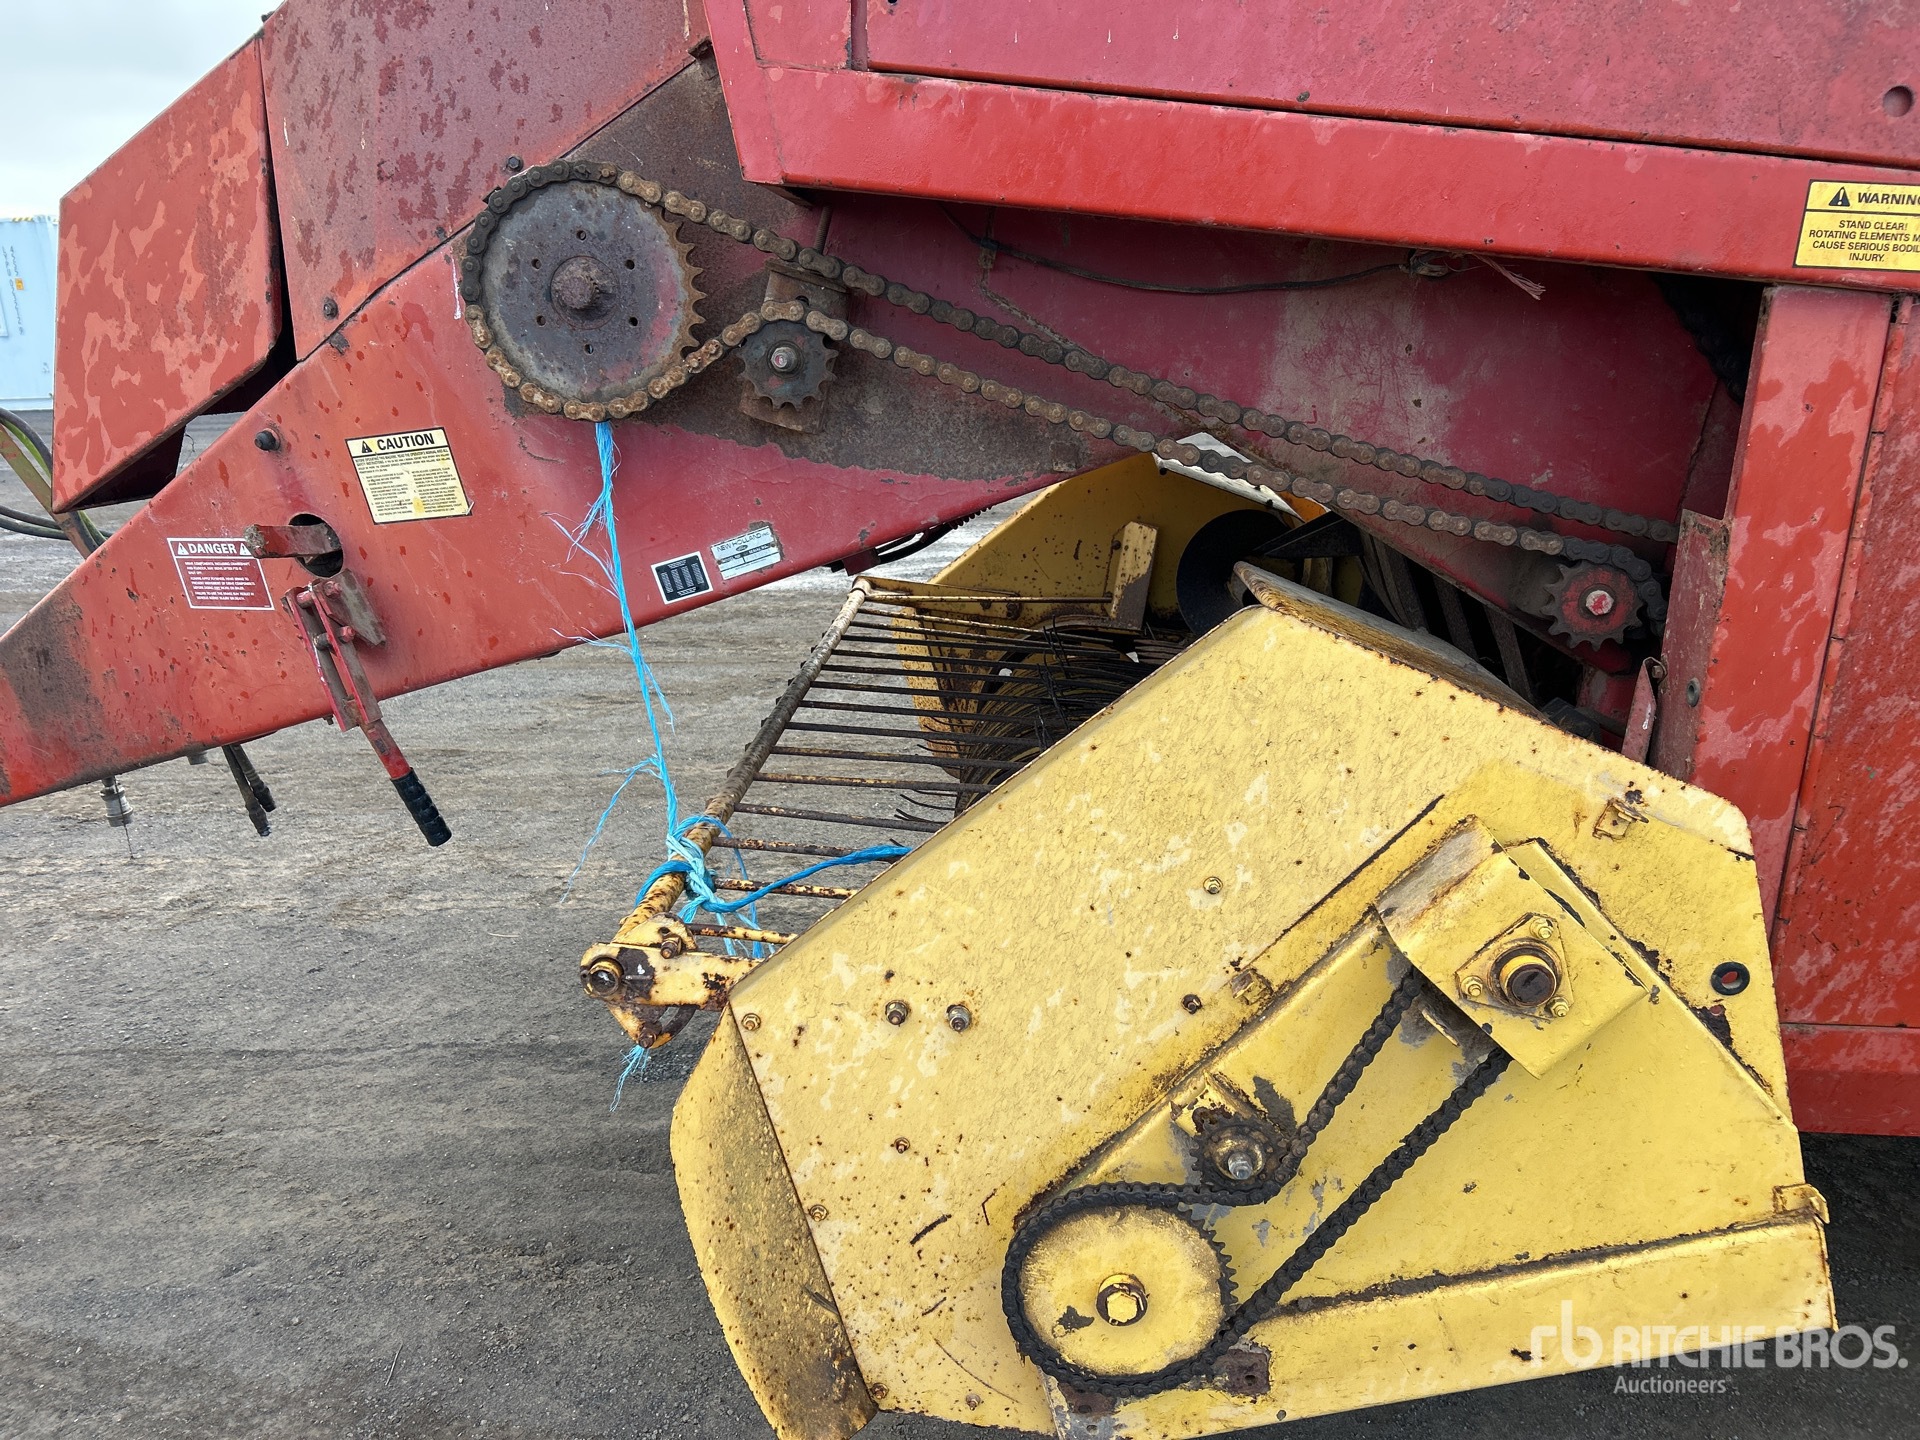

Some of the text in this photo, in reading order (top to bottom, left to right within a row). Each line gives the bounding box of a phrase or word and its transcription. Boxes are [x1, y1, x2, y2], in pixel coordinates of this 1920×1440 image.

[1857, 192, 1920, 206] WARNIN
[1839, 220, 1908, 231] STAND CLEAR!
[1809, 230, 1857, 240] ROTATING
[1859, 232, 1910, 242] ELEMENTS
[1812, 240, 1846, 250] CAUSE
[1848, 242, 1890, 252] SERIOUS
[1849, 252, 1885, 262] INJURY.
[376, 432, 435, 451] CAUTION
[187, 543, 238, 554] DANGER
[716, 543, 732, 552] NEW
[732, 533, 762, 546] HOLLAND
